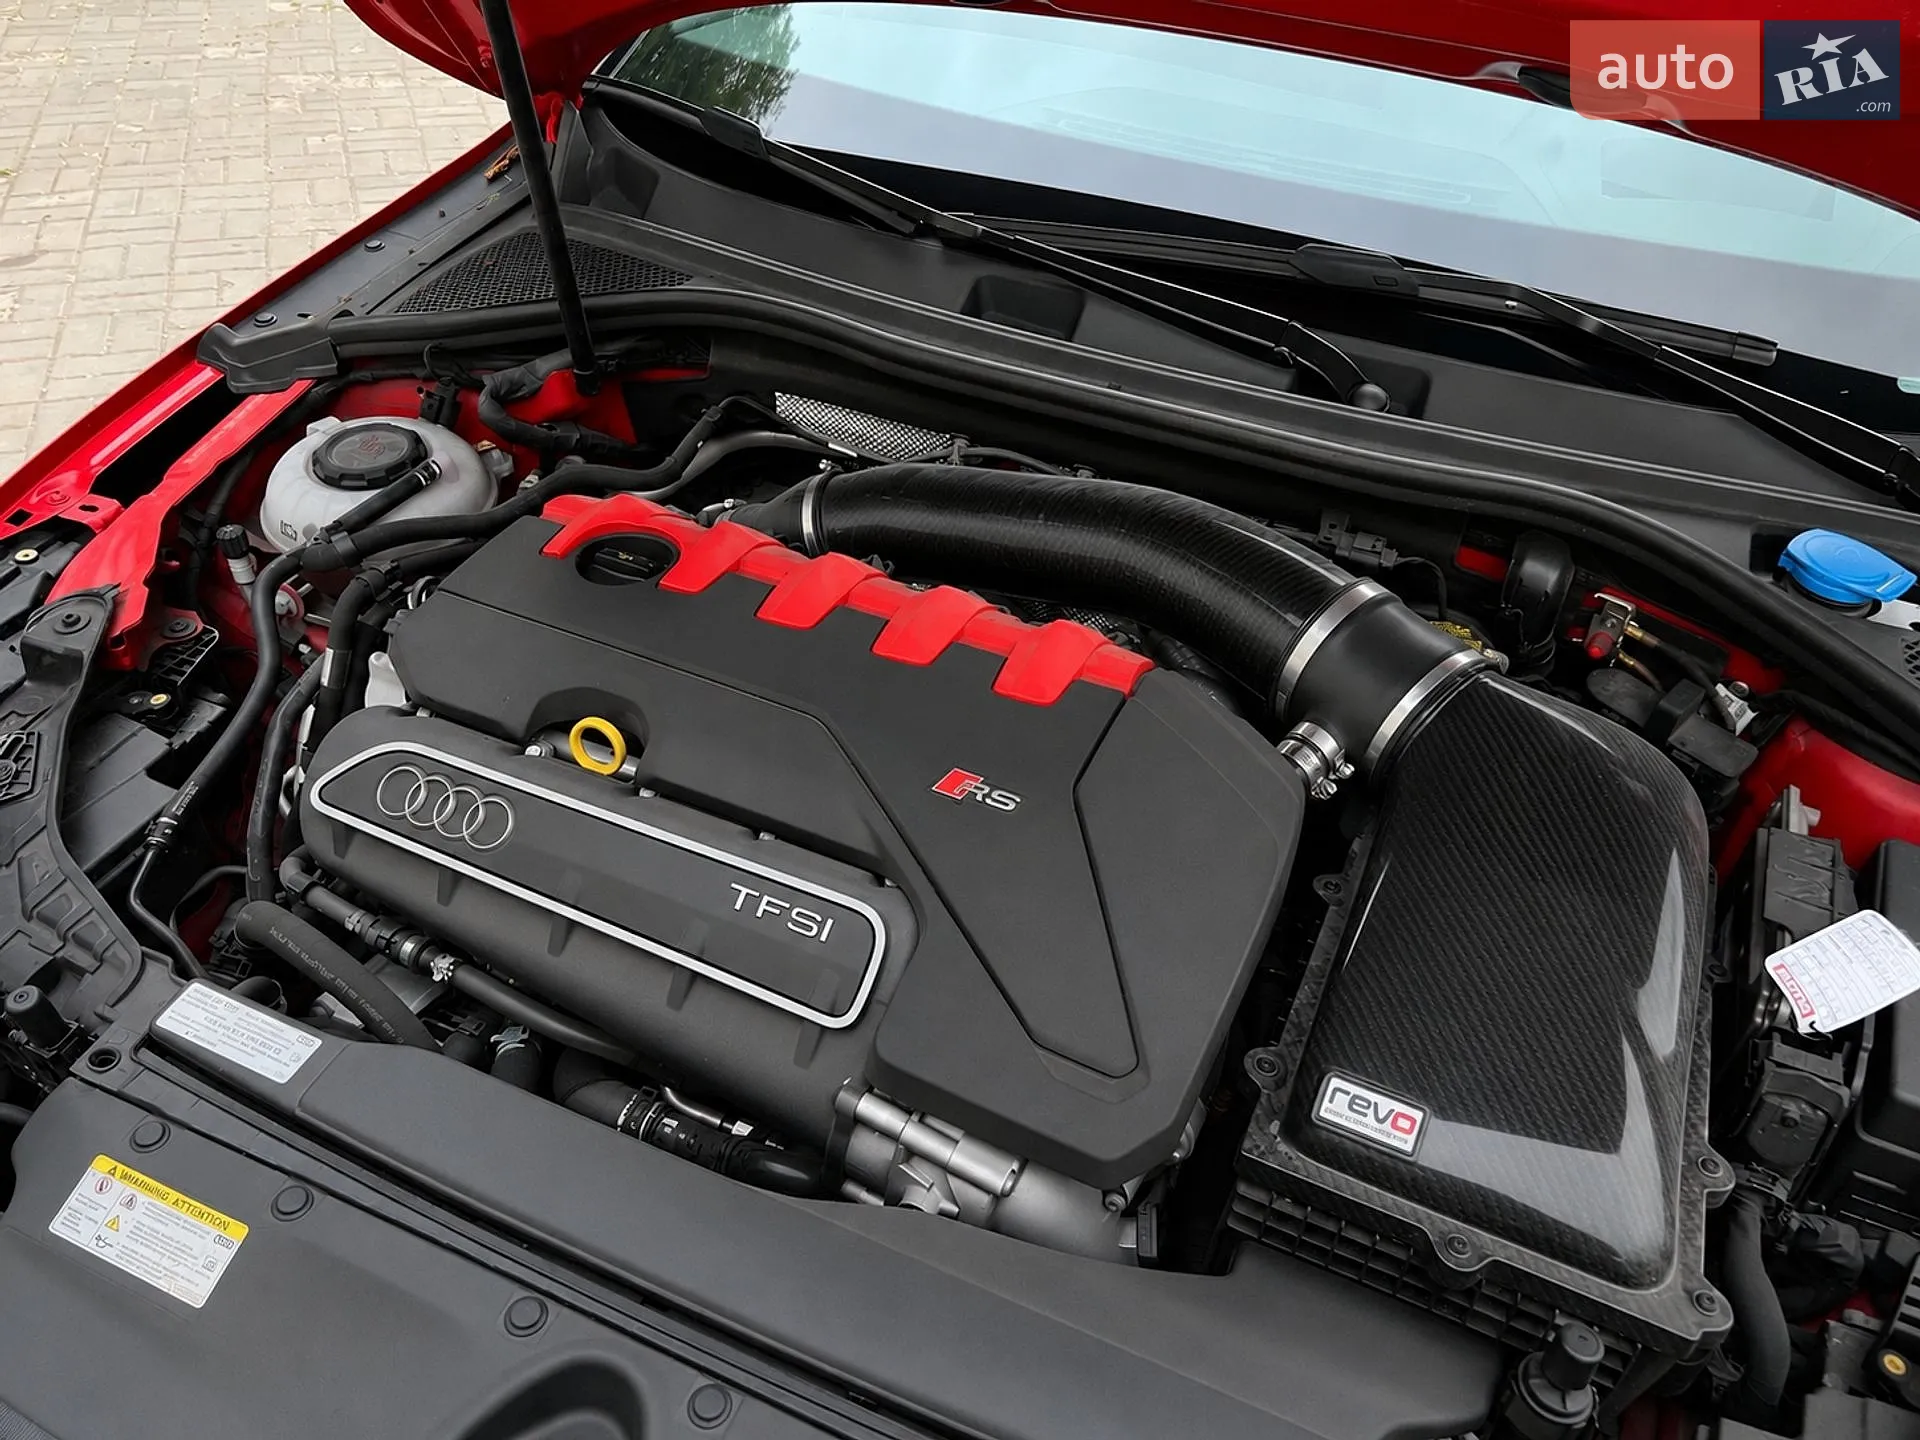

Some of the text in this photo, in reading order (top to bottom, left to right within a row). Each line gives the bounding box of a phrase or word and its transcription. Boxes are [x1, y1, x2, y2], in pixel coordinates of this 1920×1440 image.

[953, 780, 1021, 811] RS
[730, 883, 833, 942] TFSI
[1328, 1086, 1417, 1135] revo
[171, 1195, 232, 1232] ATTENTION
